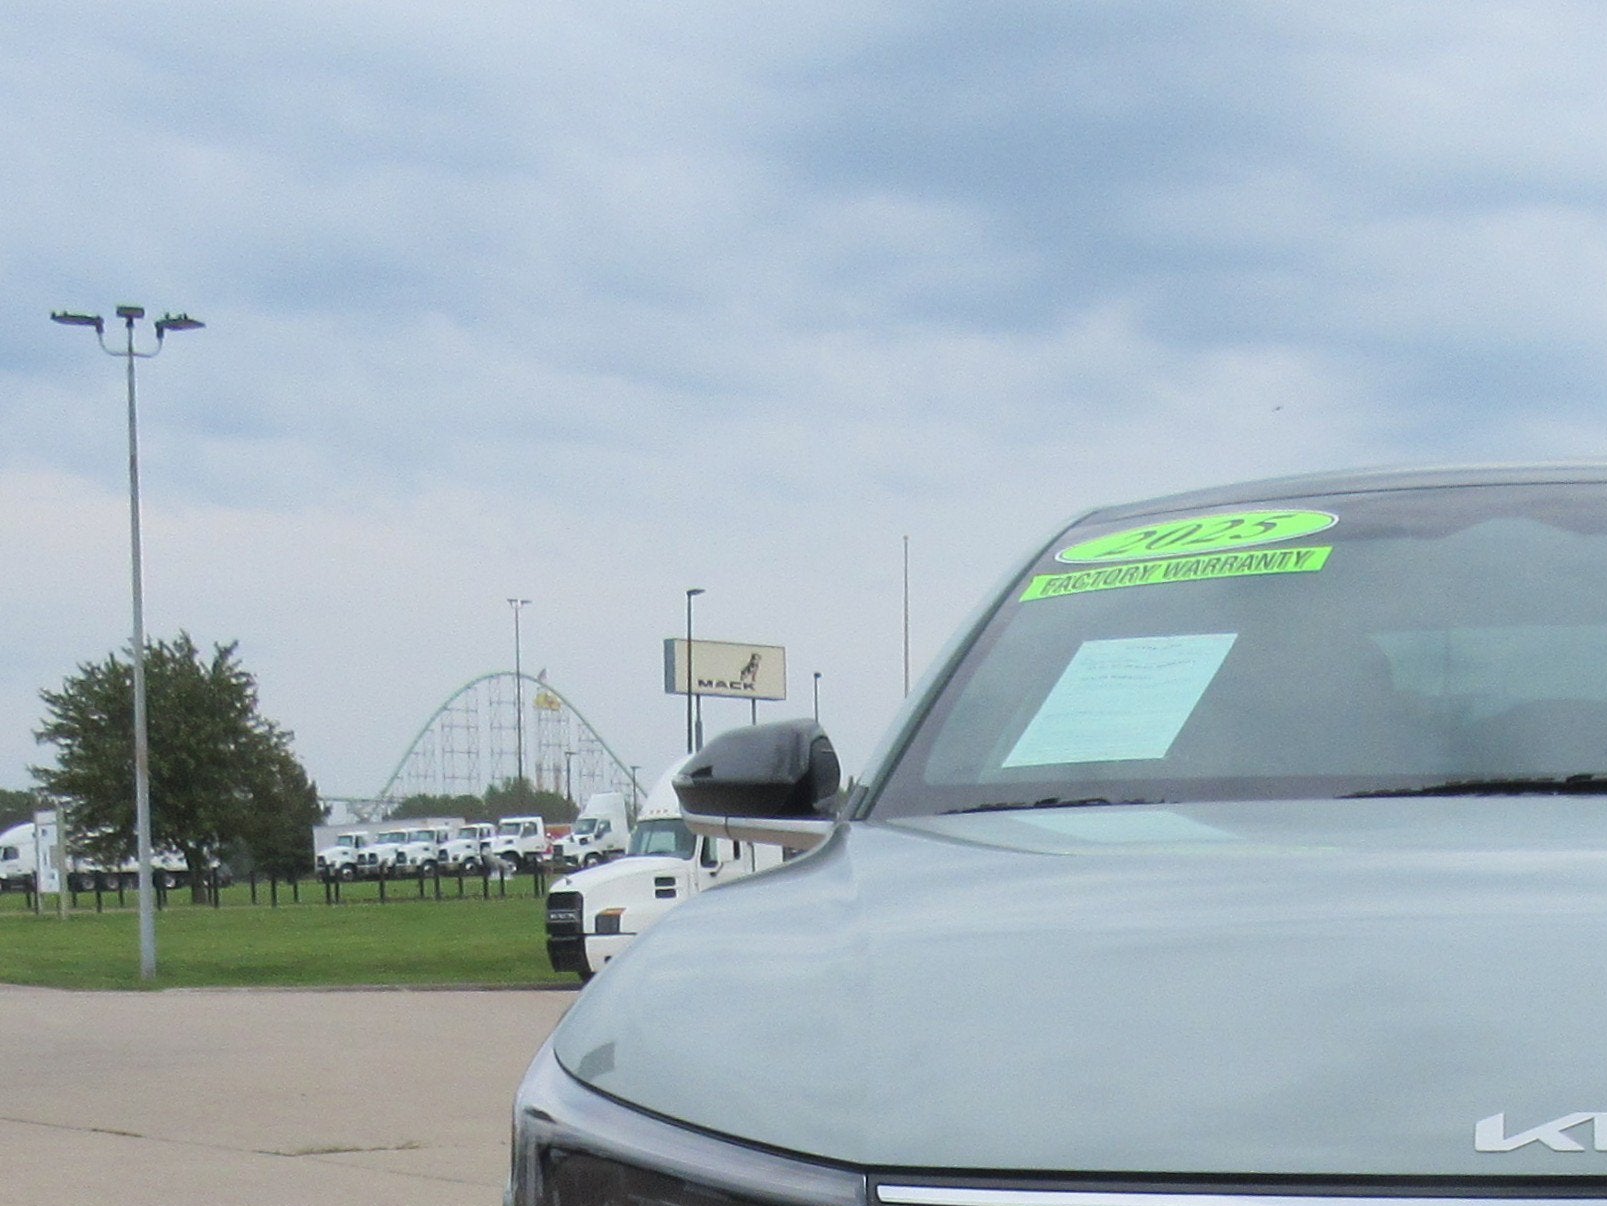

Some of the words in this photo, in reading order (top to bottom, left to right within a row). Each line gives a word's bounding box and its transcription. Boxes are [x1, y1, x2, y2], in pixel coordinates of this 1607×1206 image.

[1101, 513, 1297, 557] 2025
[1039, 563, 1160, 596] FACTORY
[1163, 549, 1314, 579] WARRANTY
[698, 679, 756, 691] MACK
